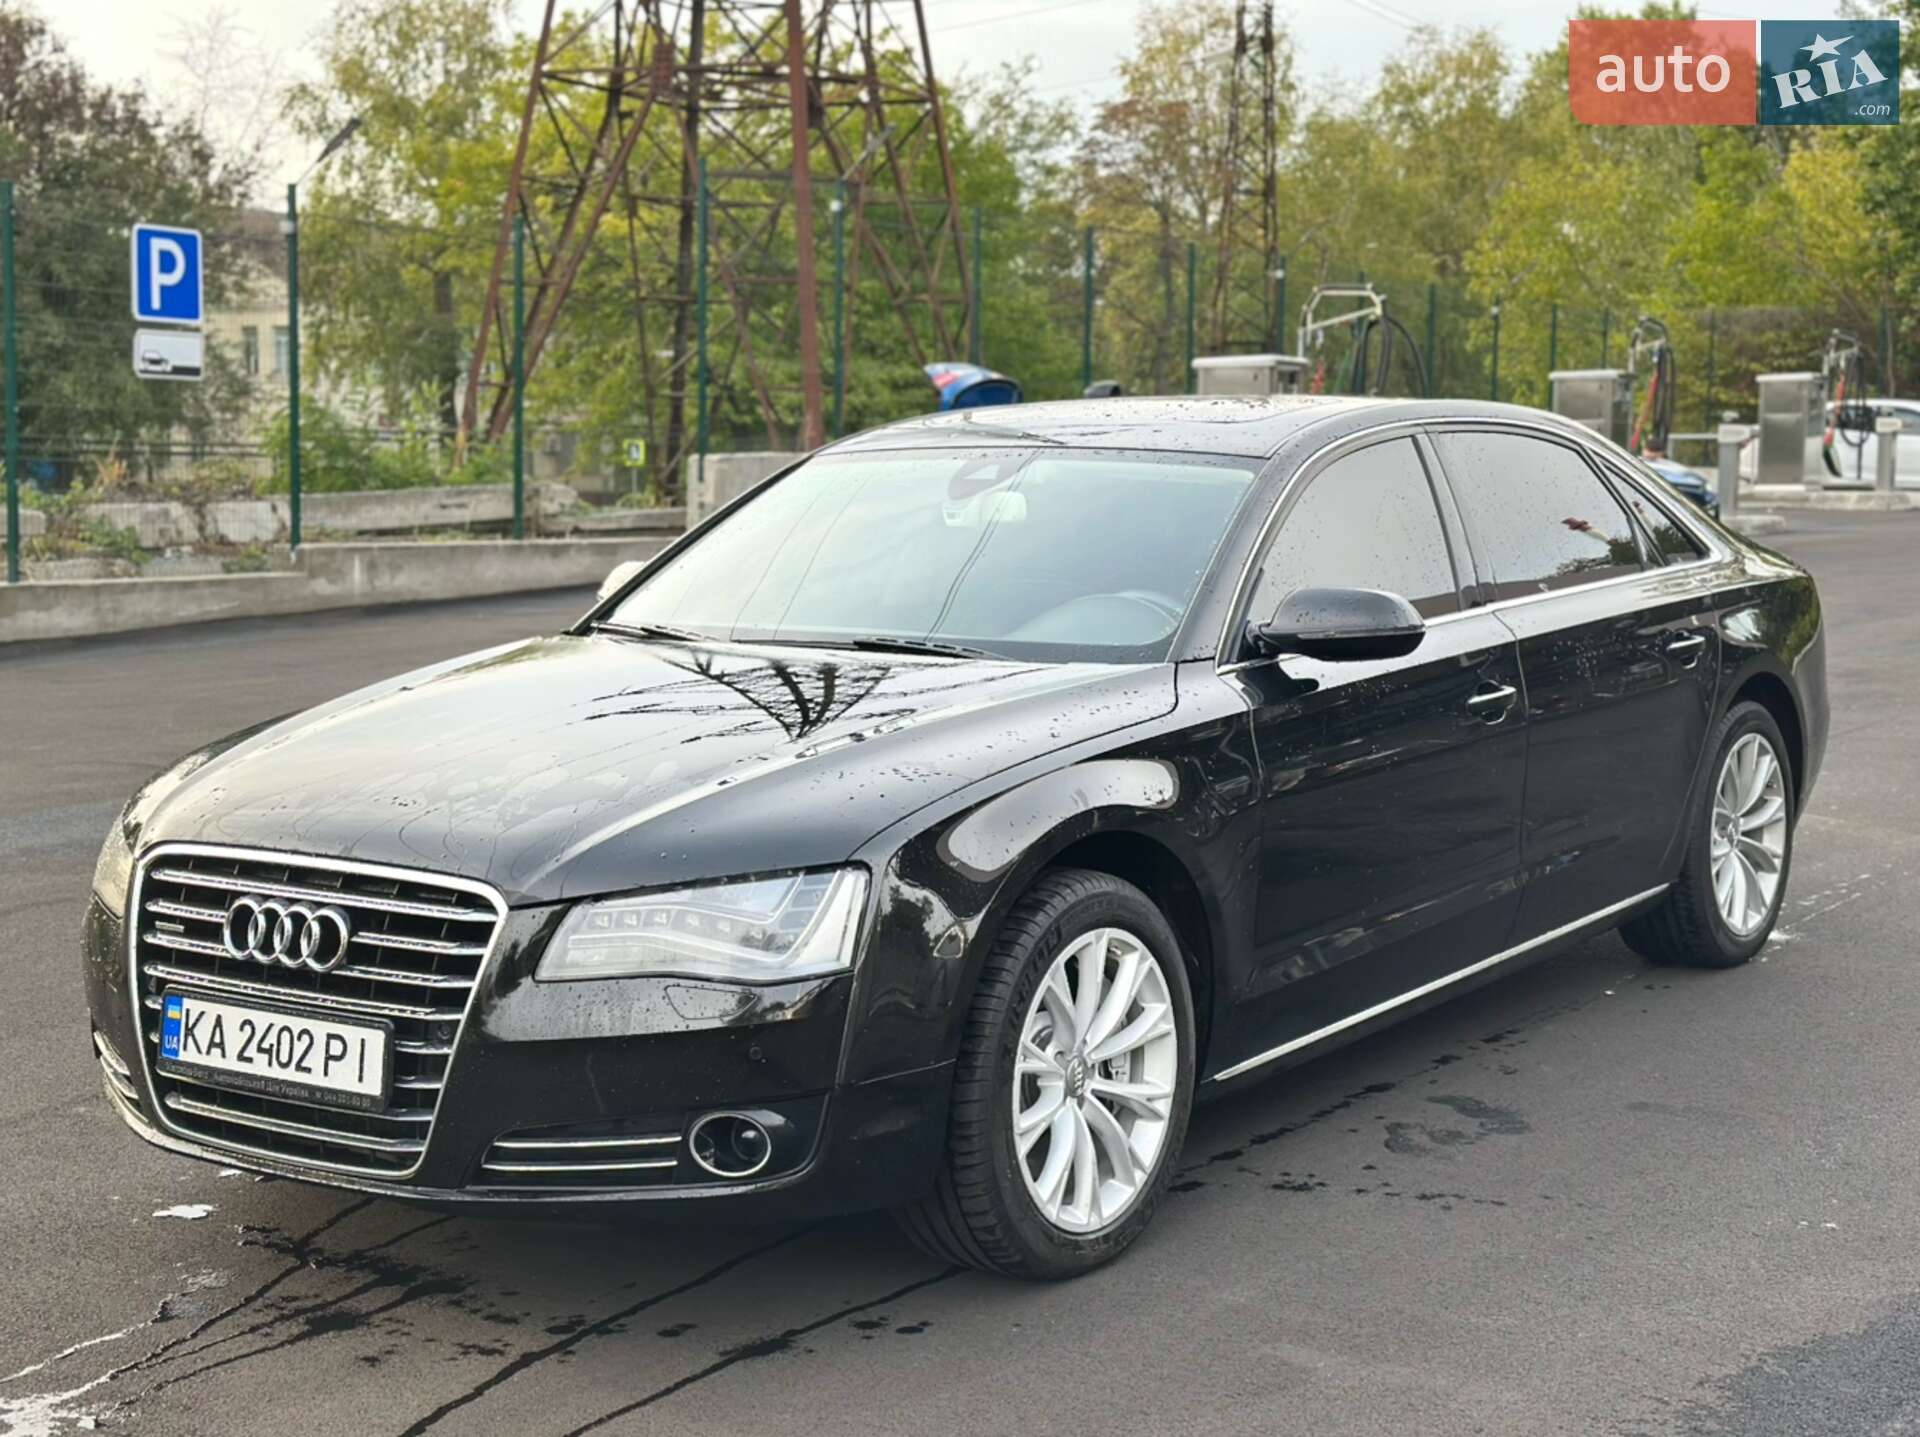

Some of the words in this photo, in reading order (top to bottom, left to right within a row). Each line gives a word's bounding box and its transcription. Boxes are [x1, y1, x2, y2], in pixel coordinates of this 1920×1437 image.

[150, 237, 186, 310] P
[164, 1036, 178, 1050] UA
[182, 1008, 227, 1059] KA
[236, 1018, 315, 1075] 2402
[323, 1032, 366, 1083] PI
